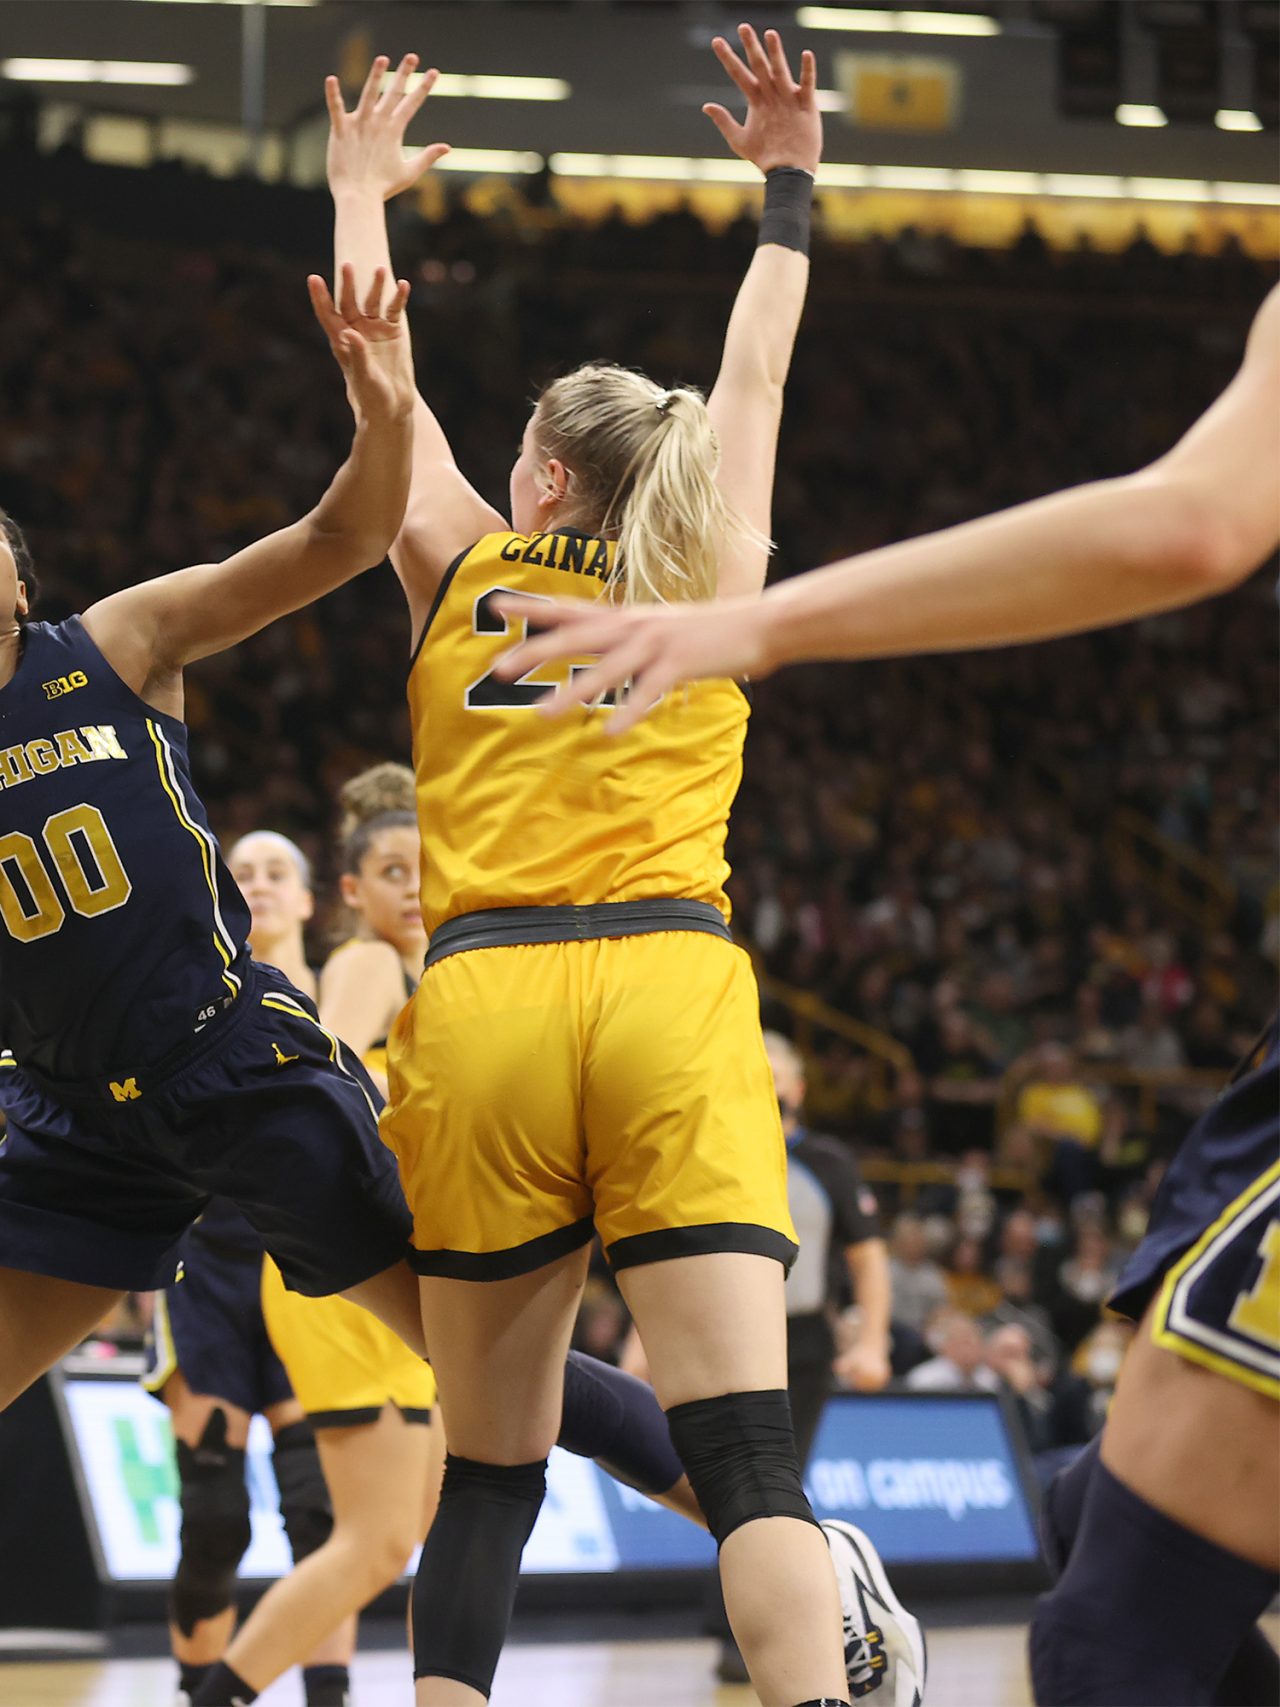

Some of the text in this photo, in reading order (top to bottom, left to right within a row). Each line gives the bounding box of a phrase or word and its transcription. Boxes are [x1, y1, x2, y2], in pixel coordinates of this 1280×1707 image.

[197, 1005, 216, 1021] 46
[108, 1077, 143, 1102] M
[808, 1457, 1015, 1521] on campus
